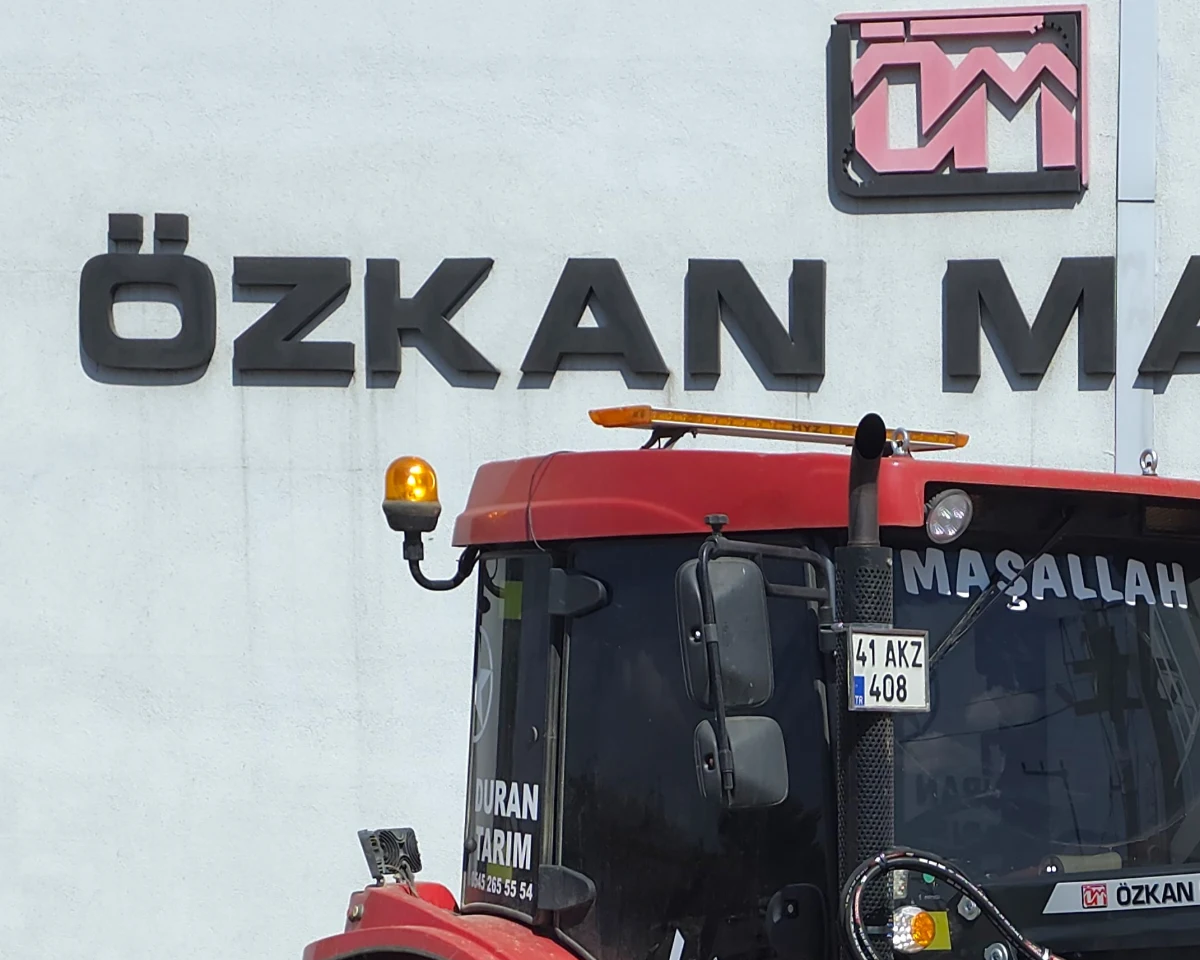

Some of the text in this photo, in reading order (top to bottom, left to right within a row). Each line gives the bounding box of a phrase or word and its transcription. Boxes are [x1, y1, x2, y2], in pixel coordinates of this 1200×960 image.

[80, 213, 827, 378] ÖZKAN
[900, 547, 1188, 611] MAŞALLAH
[856, 638, 923, 668] 41 AKZ
[855, 695, 864, 704] TR
[869, 674, 907, 702] 408
[474, 778, 539, 821] DURAN
[474, 825, 532, 871] TARIM
[486, 875, 502, 895] 265
[503, 879, 517, 898] 55
[519, 882, 533, 901] 54
[1116, 882, 1194, 906] ÖZKAN
